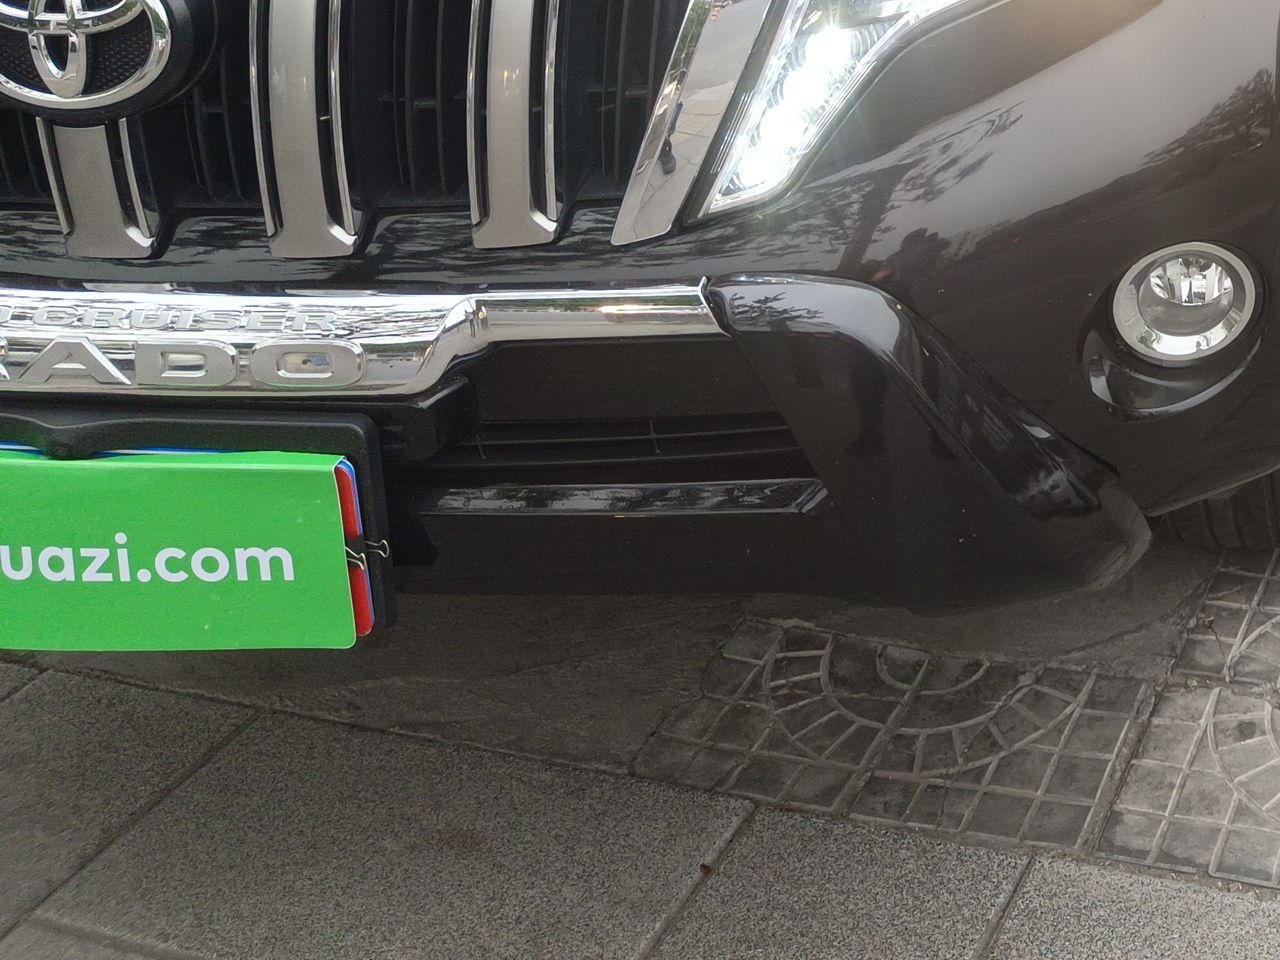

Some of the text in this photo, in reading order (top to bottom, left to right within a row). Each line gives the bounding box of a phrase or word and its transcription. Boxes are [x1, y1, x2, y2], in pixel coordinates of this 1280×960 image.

[33, 305, 346, 332] CRUISER
[0, 336, 366, 387] ADO
[0, 532, 295, 583] uazi.com
